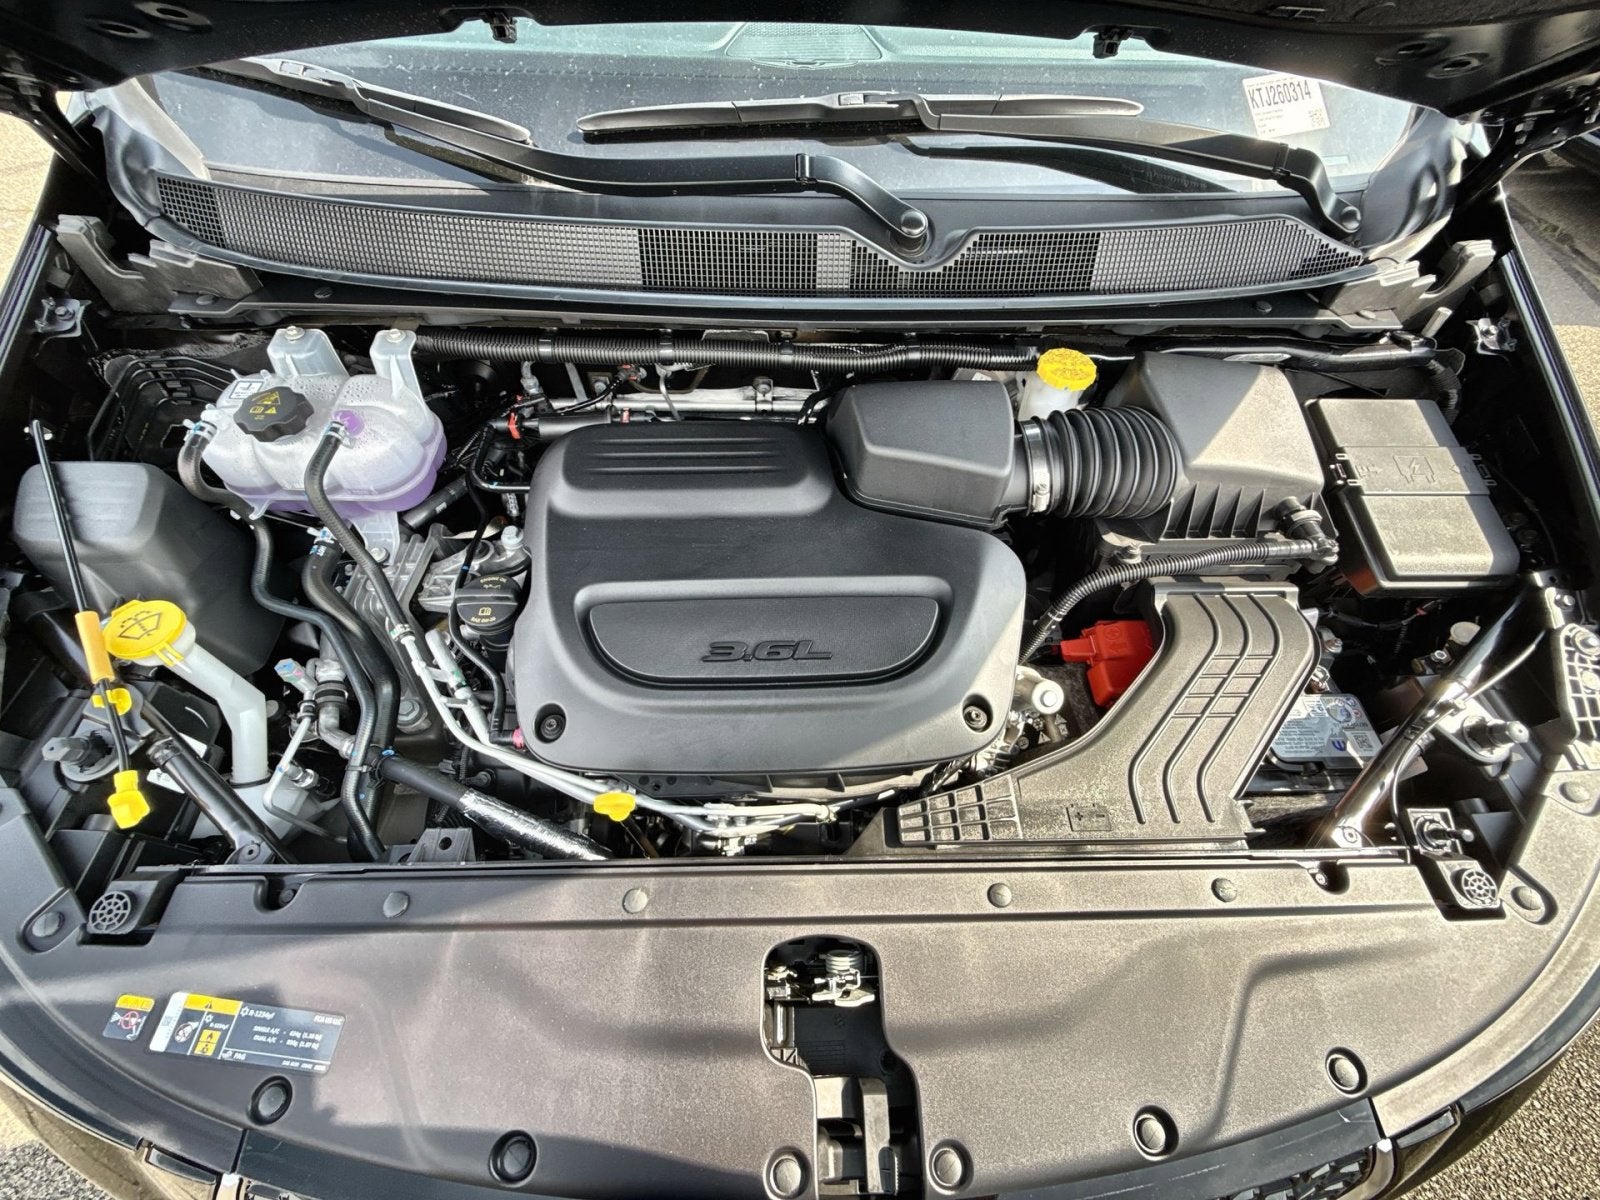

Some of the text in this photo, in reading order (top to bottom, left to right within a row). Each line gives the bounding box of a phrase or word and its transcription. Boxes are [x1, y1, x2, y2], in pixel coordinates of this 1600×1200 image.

[1248, 80, 1311, 109] KTJ260314
[701, 640, 833, 662] 3.6L
[249, 1009, 275, 1020] R-1234yf
